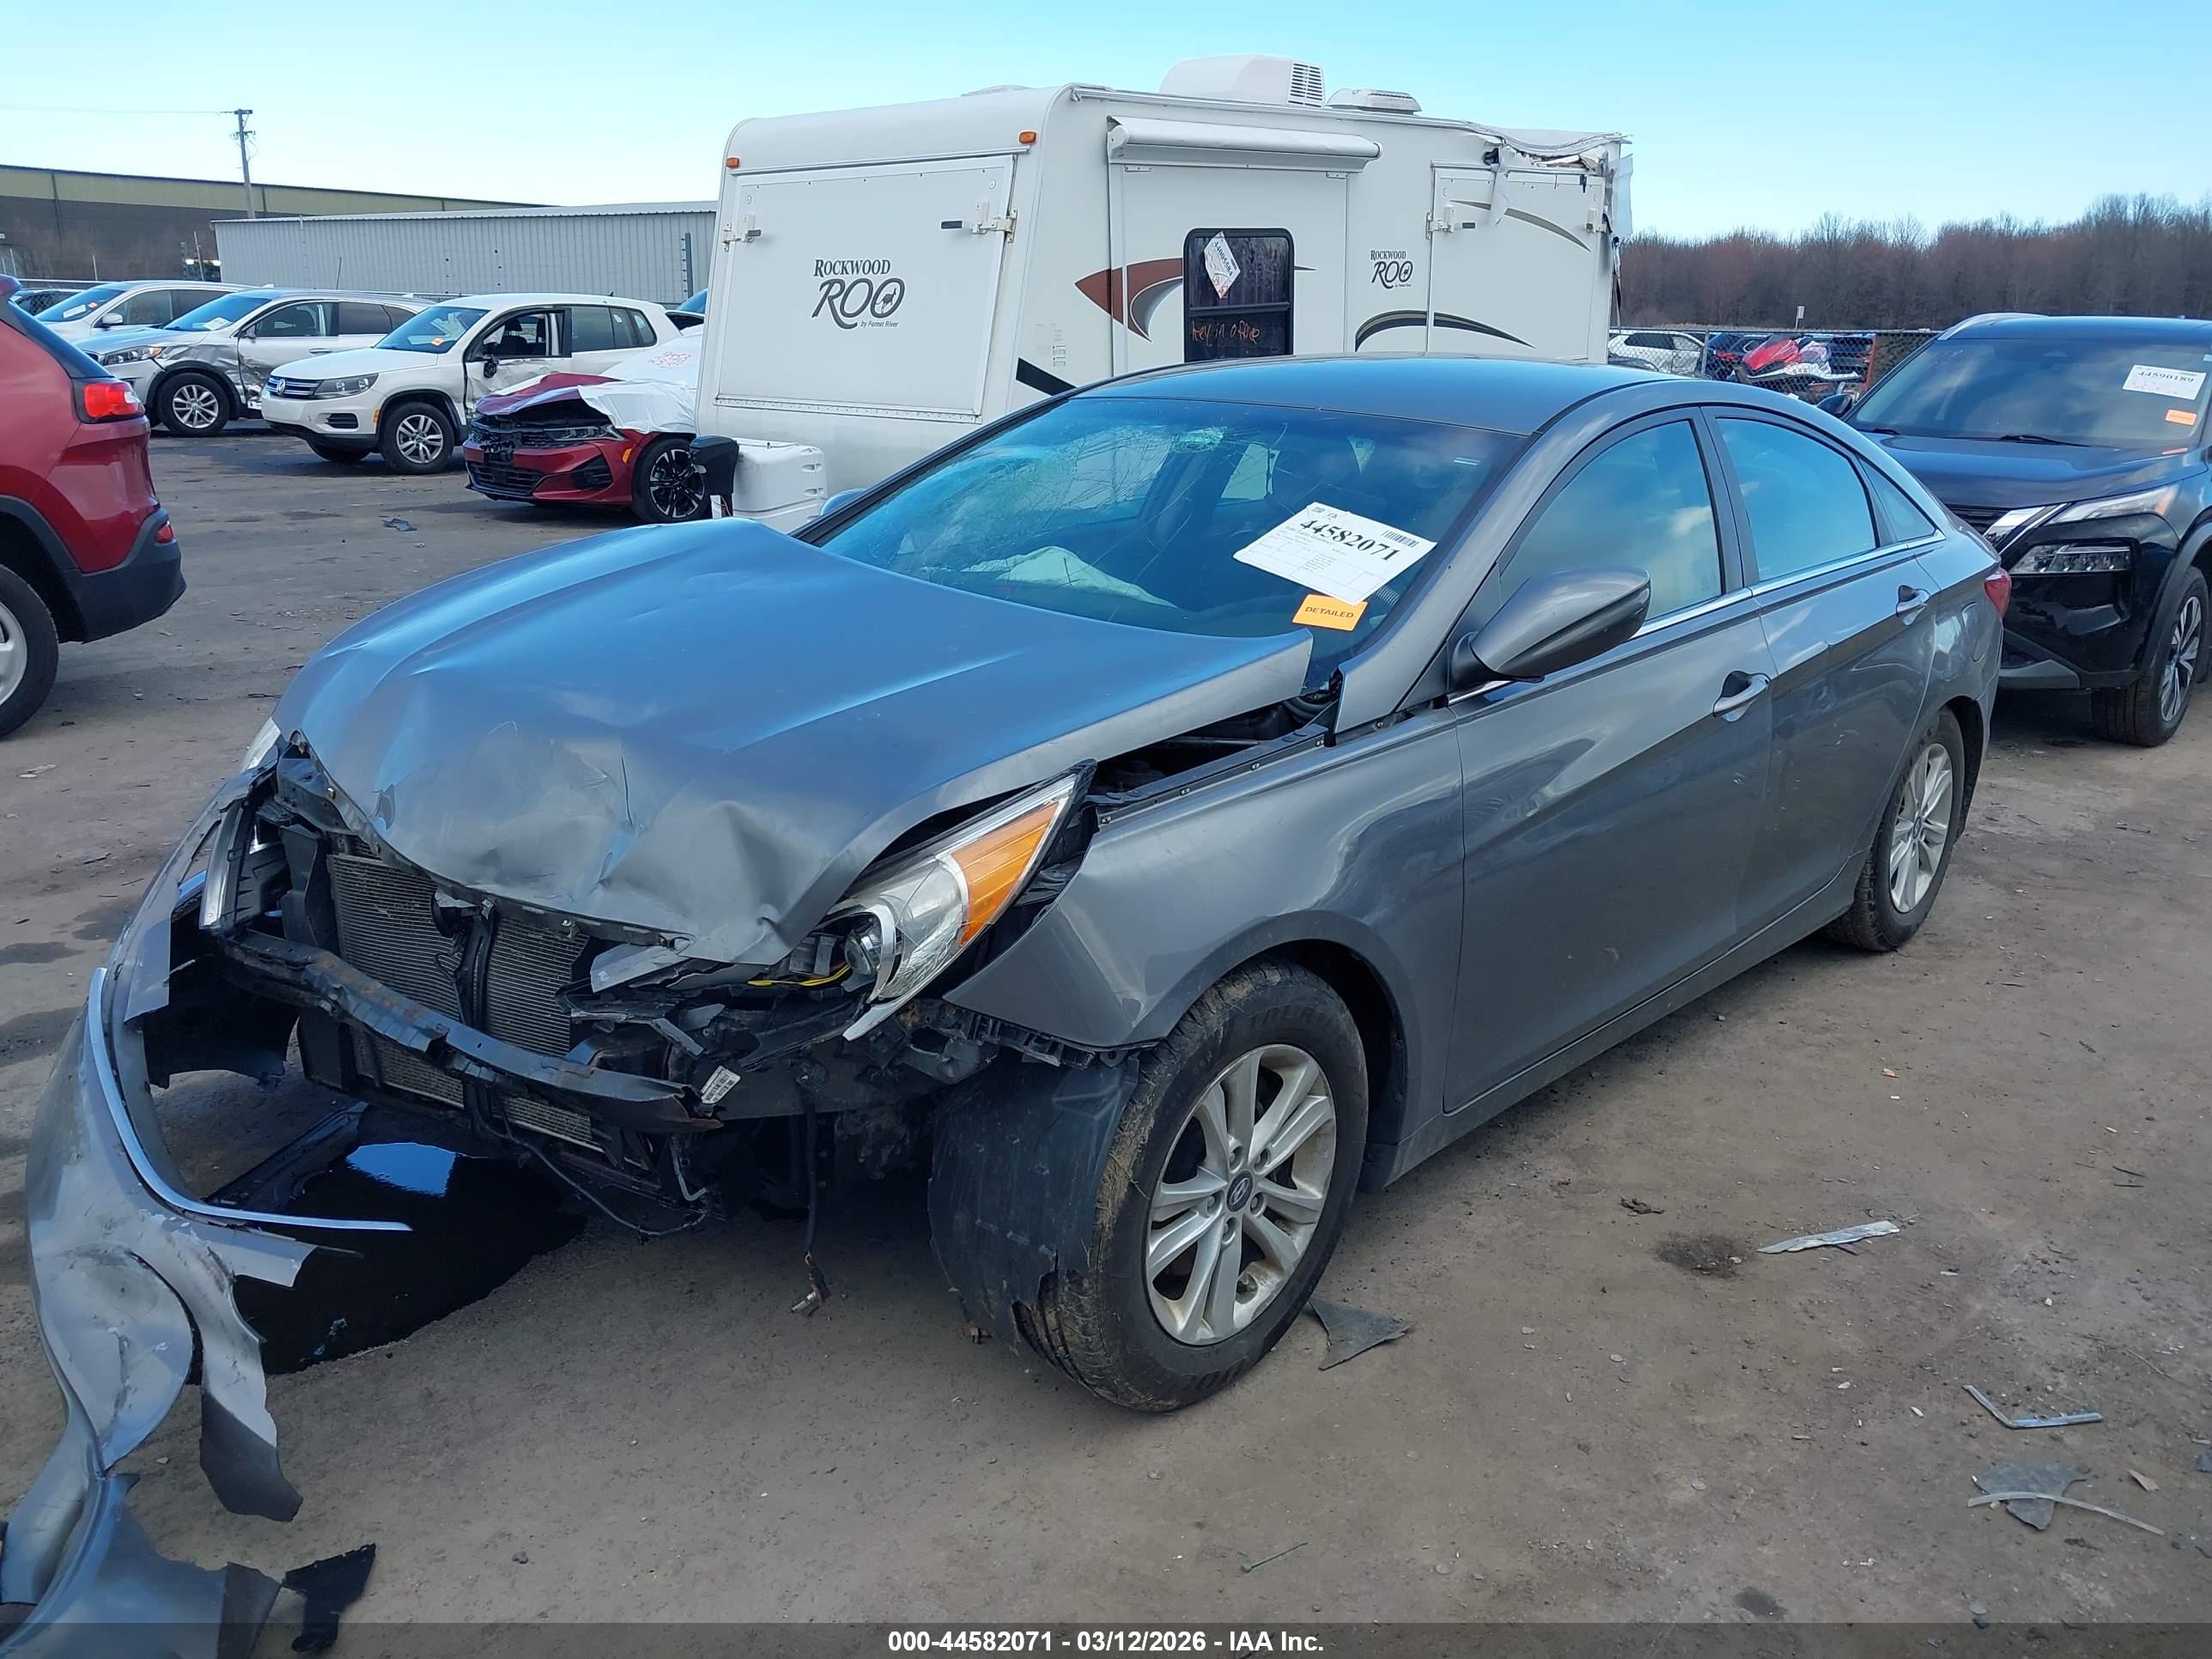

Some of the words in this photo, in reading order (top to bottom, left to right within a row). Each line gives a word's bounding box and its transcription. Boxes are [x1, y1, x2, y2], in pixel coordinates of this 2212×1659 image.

[1370, 250, 1407, 261] ROCKWOOD
[813, 259, 891, 277] ROCKWOOD
[1370, 260, 1413, 289] ROO
[811, 277, 905, 330] ROO
[1299, 519, 1401, 562] 44582071
[1304, 605, 1354, 619] DETAILED
